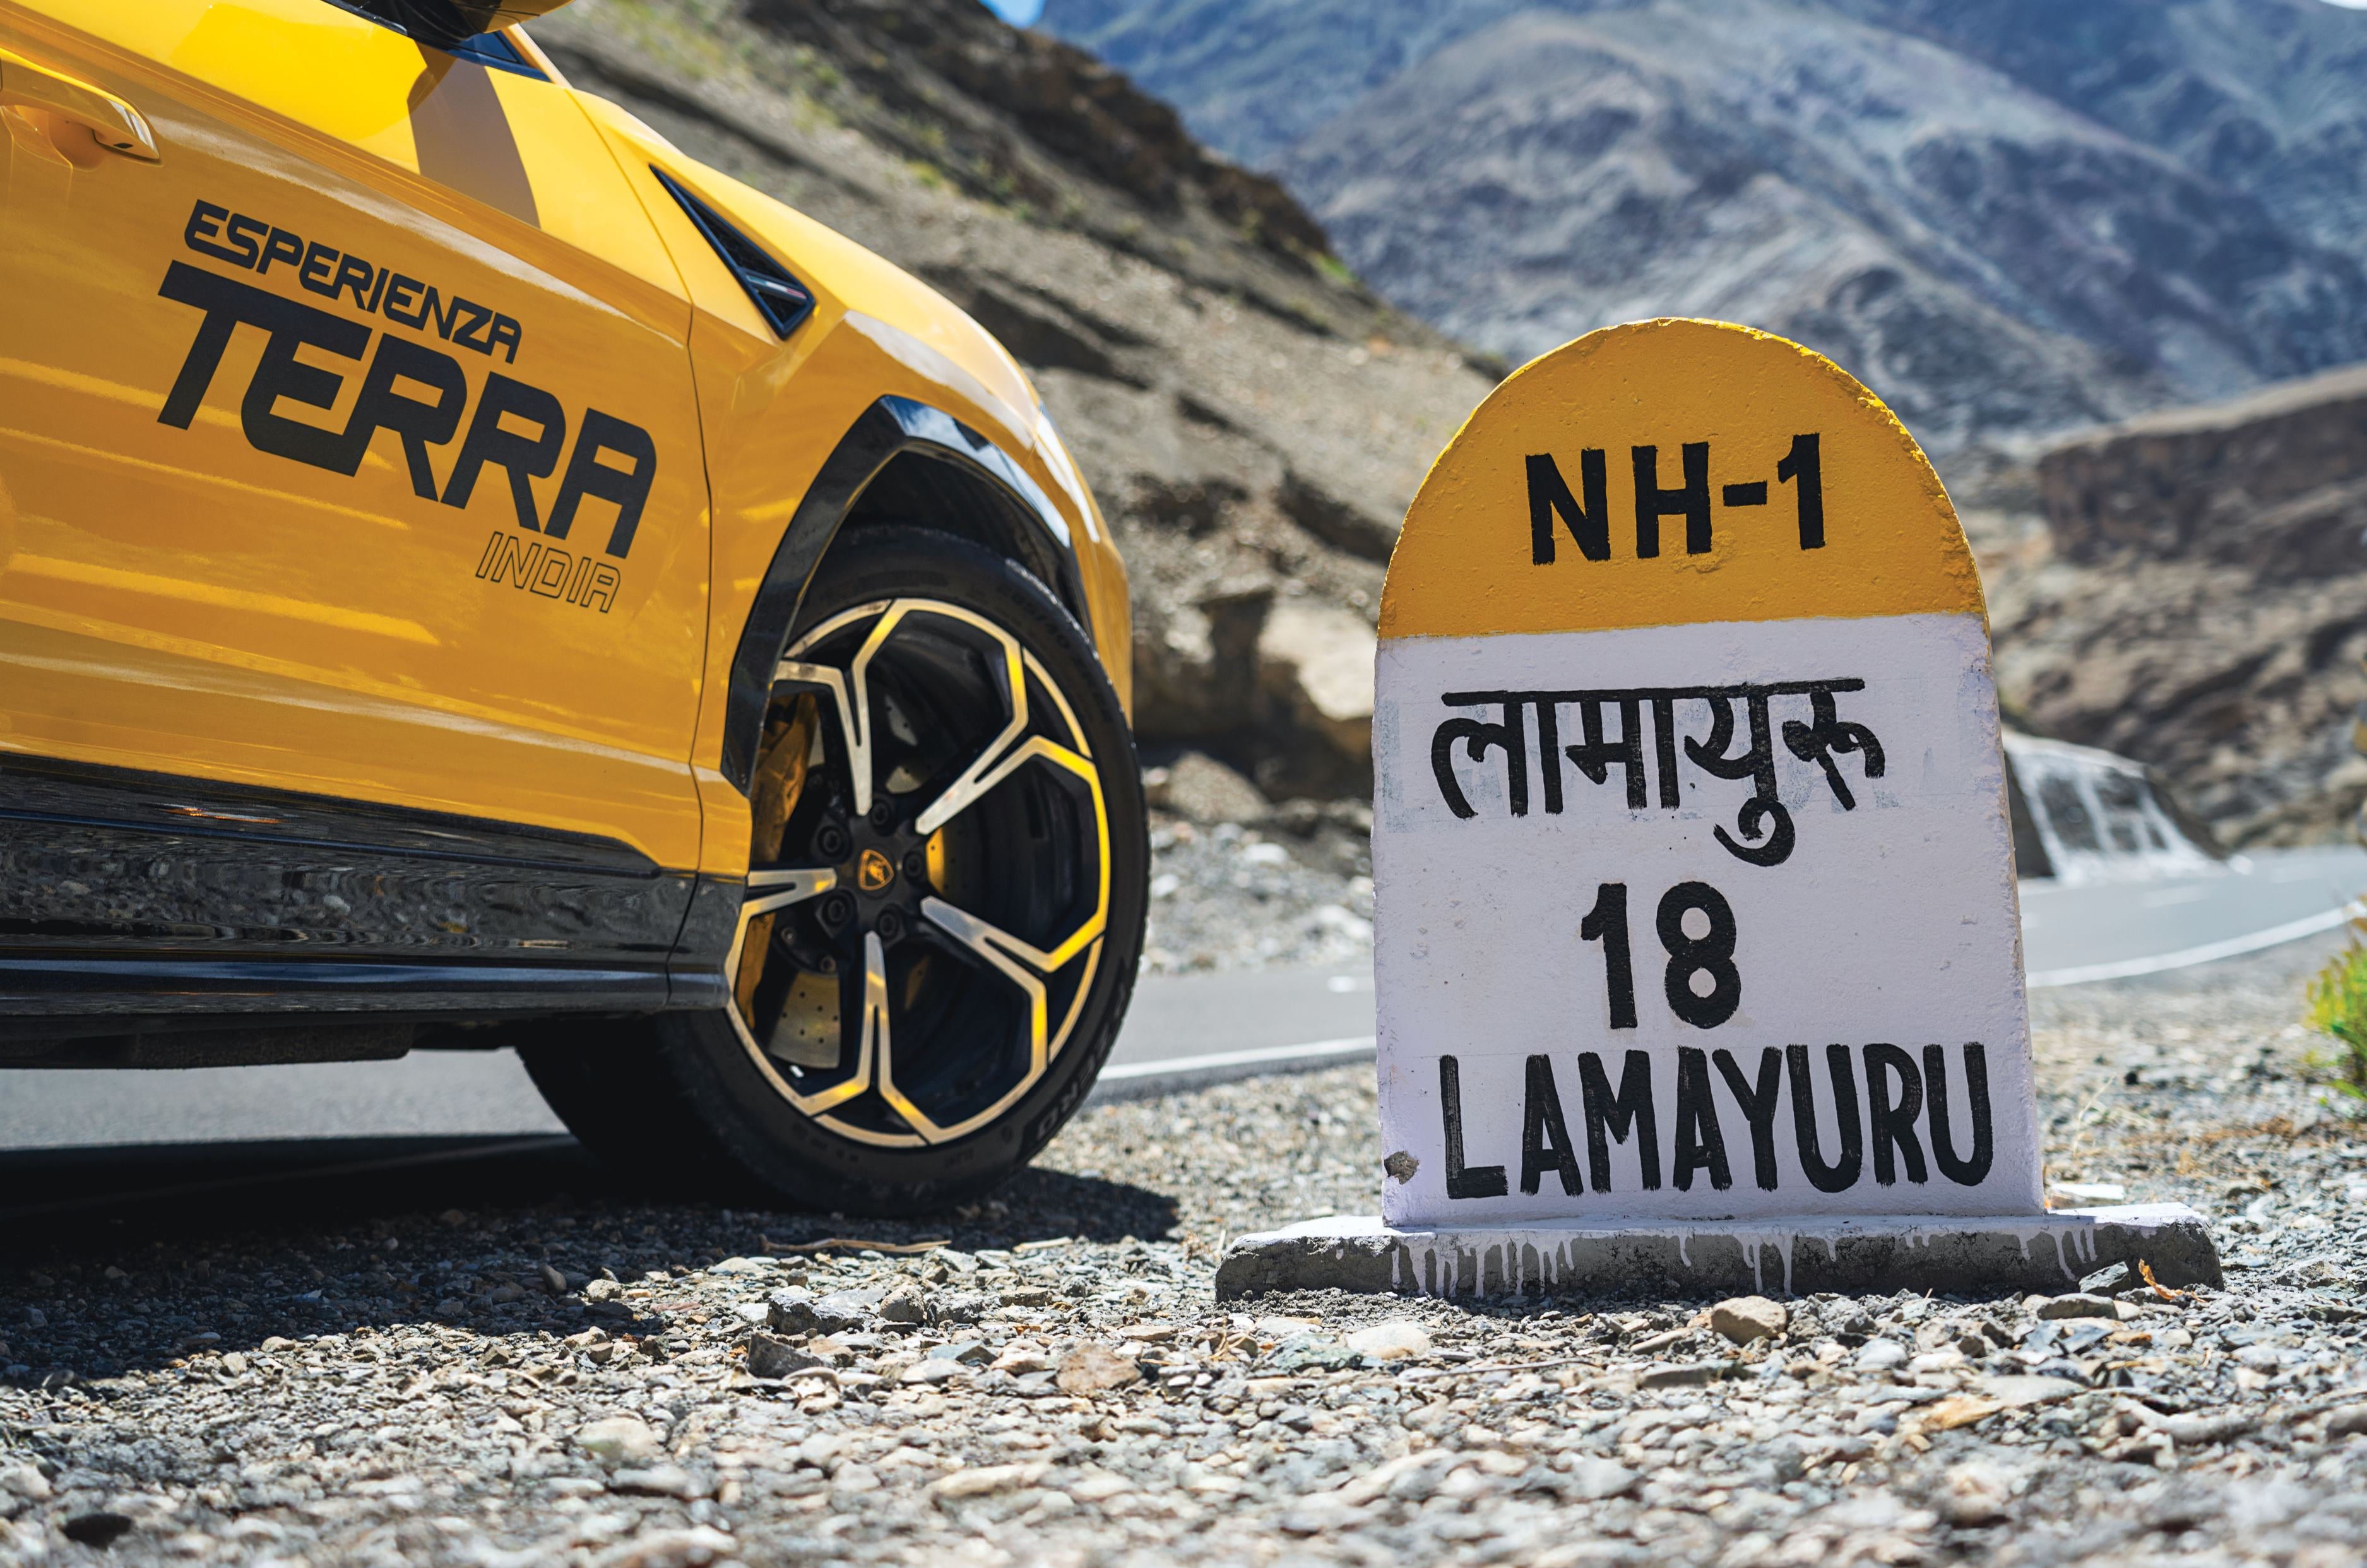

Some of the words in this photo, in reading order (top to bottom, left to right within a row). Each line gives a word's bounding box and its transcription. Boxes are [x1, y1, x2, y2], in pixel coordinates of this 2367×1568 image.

[184, 198, 523, 364] ESPERIENZA
[156, 259, 657, 560] TERRA
[475, 531, 621, 614] INDIA
[1524, 432, 1826, 566] NH-1
[1580, 881, 1741, 1030] 18
[1439, 1042, 1993, 1200] LAMAYURU
